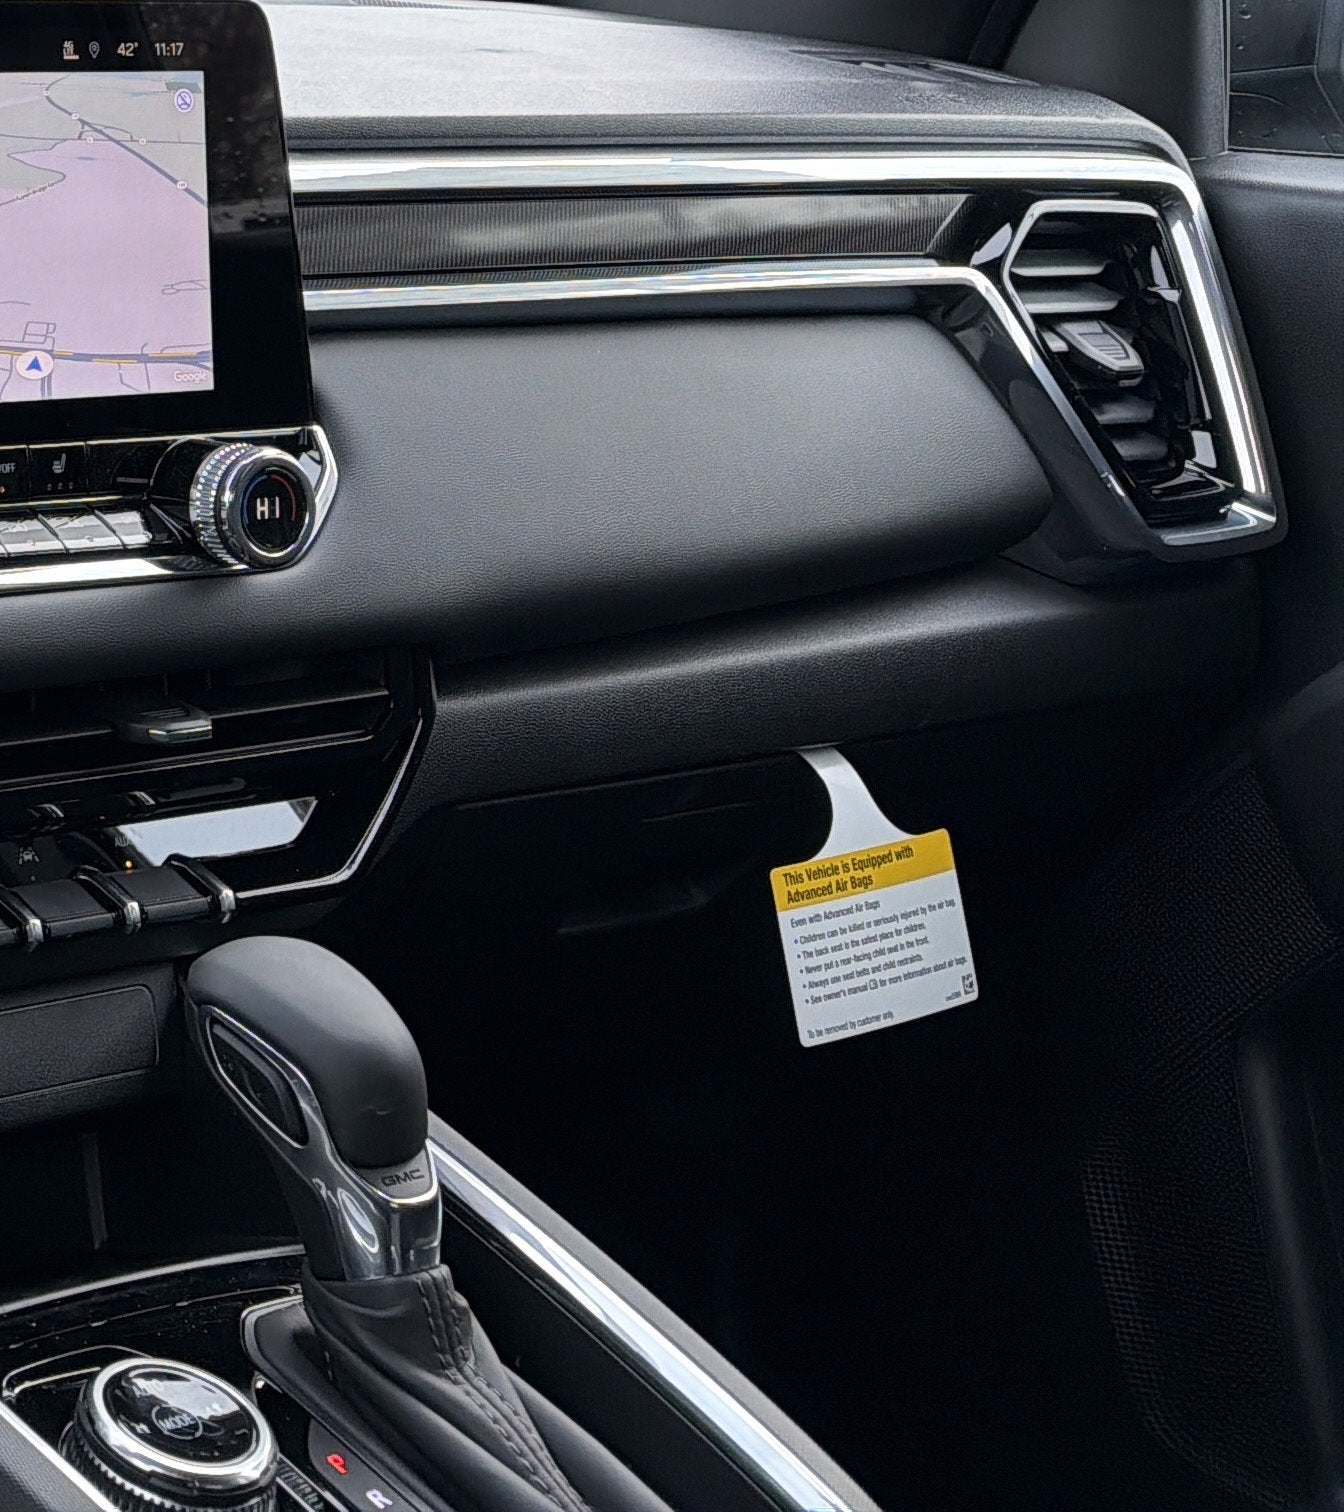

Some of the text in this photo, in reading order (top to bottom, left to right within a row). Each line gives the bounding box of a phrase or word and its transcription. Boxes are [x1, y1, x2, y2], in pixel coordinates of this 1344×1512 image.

[116, 42, 139, 57] 42°
[154, 42, 184, 57] 11:17
[173, 370, 207, 384] Google
[256, 496, 280, 521] HI
[782, 845, 915, 888] This Vehicle is Equipped with
[786, 873, 874, 904] Advanced Air Bags
[790, 899, 881, 929] Even with Advanced Air Bags
[799, 932, 826, 945] Children
[827, 930, 839, 939] can
[839, 926, 848, 936] be
[848, 921, 865, 934] killed
[873, 914, 900, 930] seriously
[920, 906, 928, 916] by
[928, 902, 937, 912] the
[937, 900, 945, 910] air
[802, 950, 814, 961] The
[830, 942, 843, 954] seat
[850, 938, 860, 948] the
[895, 928, 903, 938] for
[804, 963, 823, 975] Never
[823, 960, 834, 972] put
[872, 946, 886, 959] child
[906, 938, 915, 949] the
[807, 976, 830, 990] Always
[831, 975, 842, 985] use
[842, 970, 855, 982] seat
[871, 964, 882, 976] and
[882, 960, 896, 973] child
[810, 992, 823, 1005] See
[878, 977, 887, 988] for
[888, 974, 903, 986] more
[815, 1027, 824, 1037] be
[824, 1020, 850, 1035] removed
[849, 1018, 857, 1029] by
[380, 1168, 425, 1188] GMC
[159, 1413, 196, 1431] MODE
[326, 1453, 349, 1475] P
[365, 1489, 393, 1510] R
